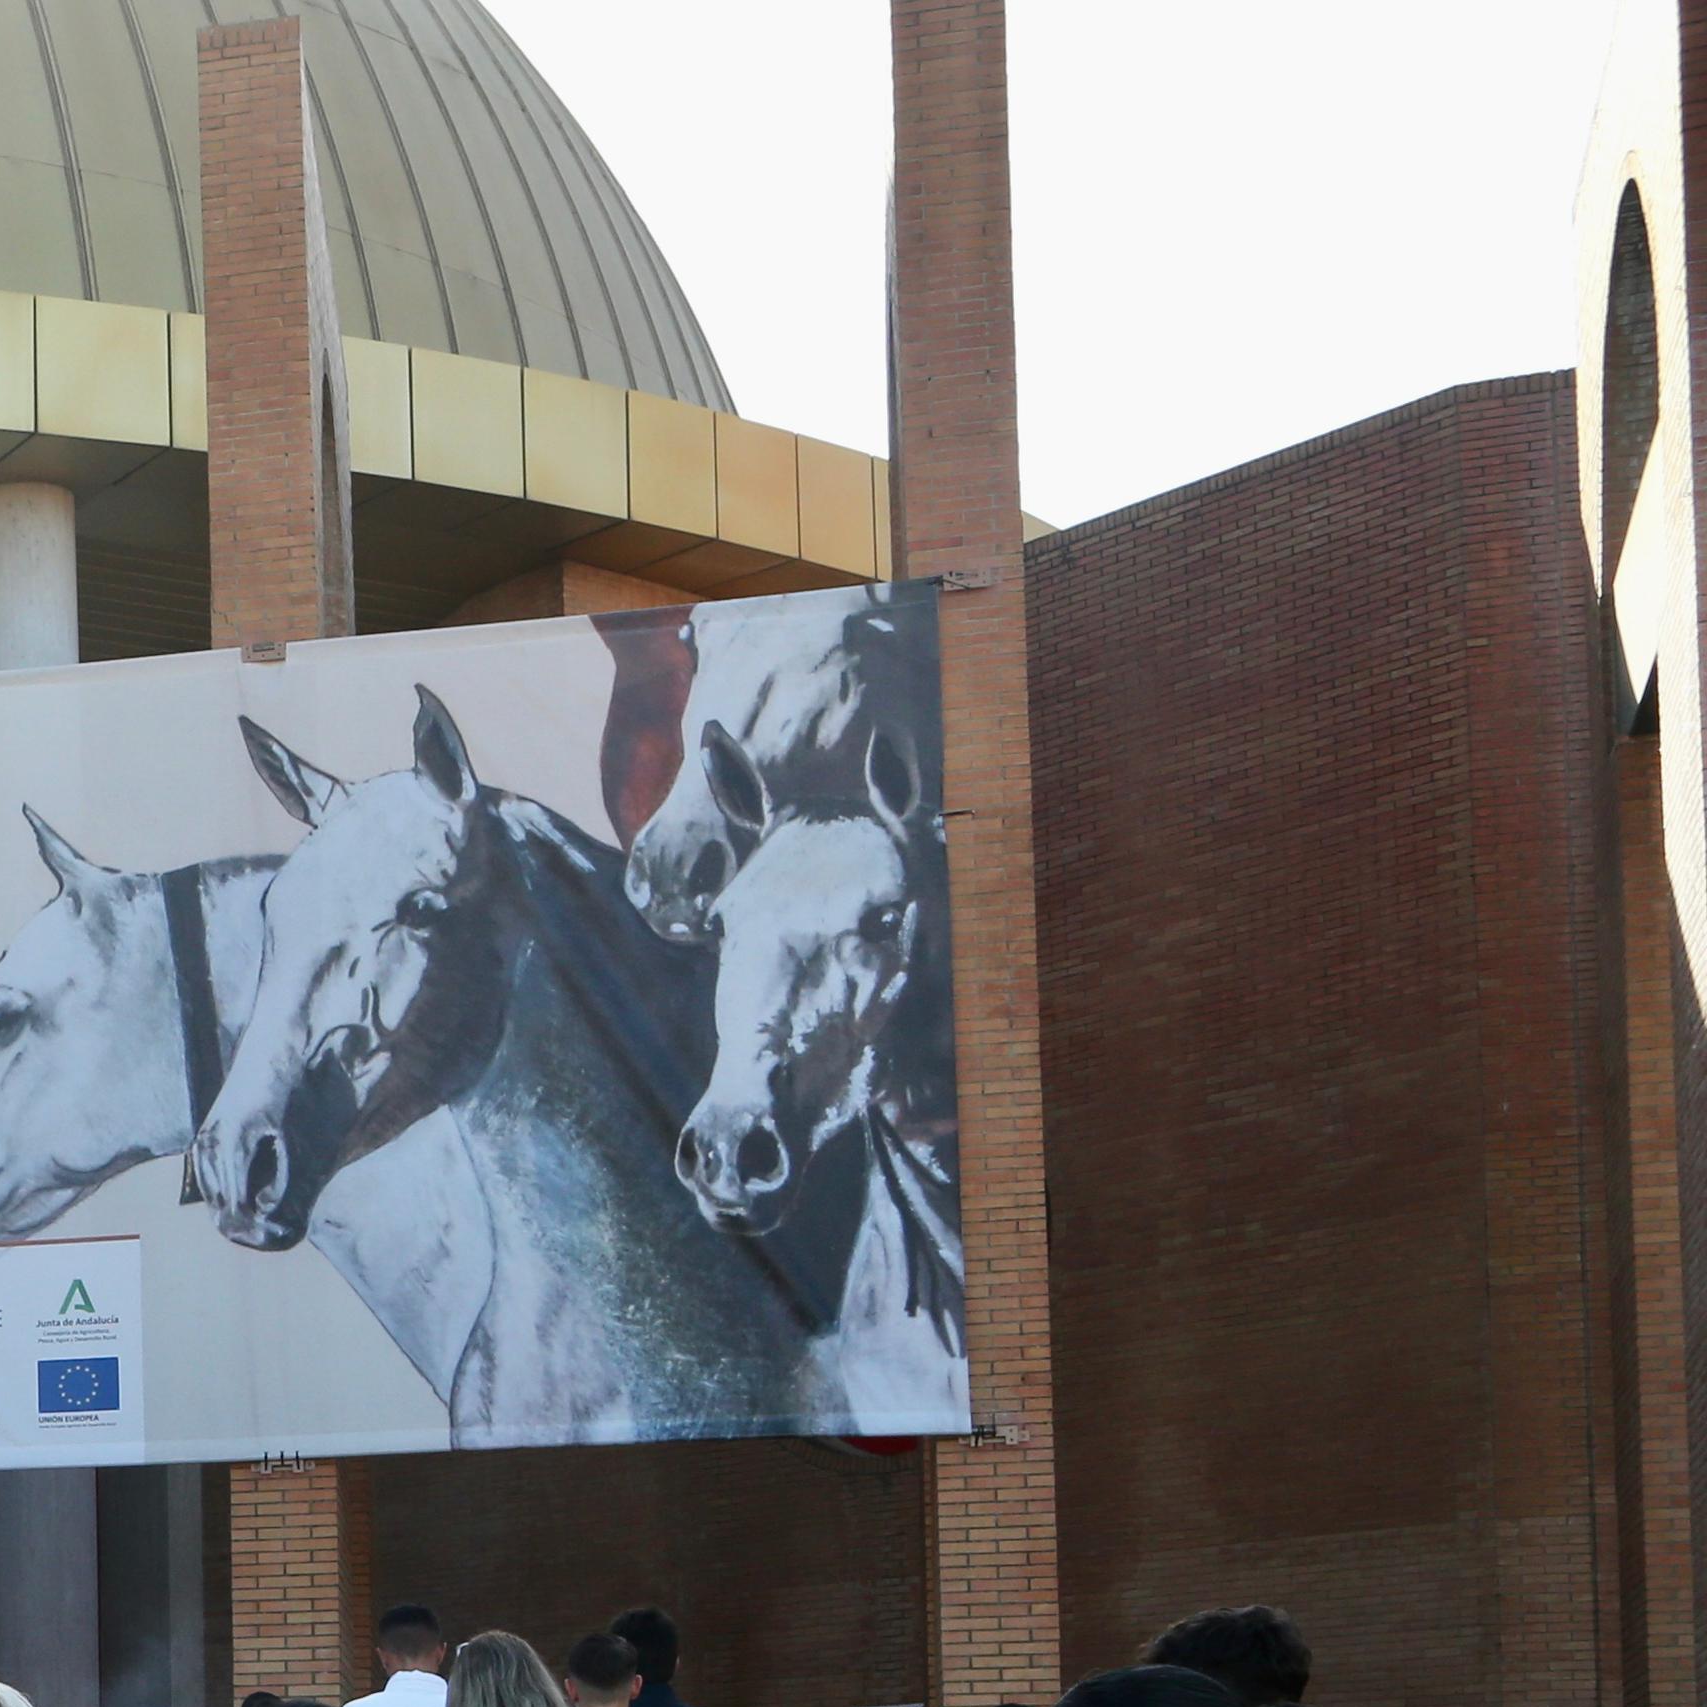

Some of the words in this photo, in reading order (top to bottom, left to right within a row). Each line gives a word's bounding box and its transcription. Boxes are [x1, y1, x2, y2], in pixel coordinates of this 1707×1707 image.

[36, 1320, 61, 1328] Junta
[62, 1318, 74, 1326] de
[75, 1315, 119, 1326] Andalucía
[38, 1415, 64, 1423] UNIÓN
[65, 1414, 99, 1422] EUROPEA
